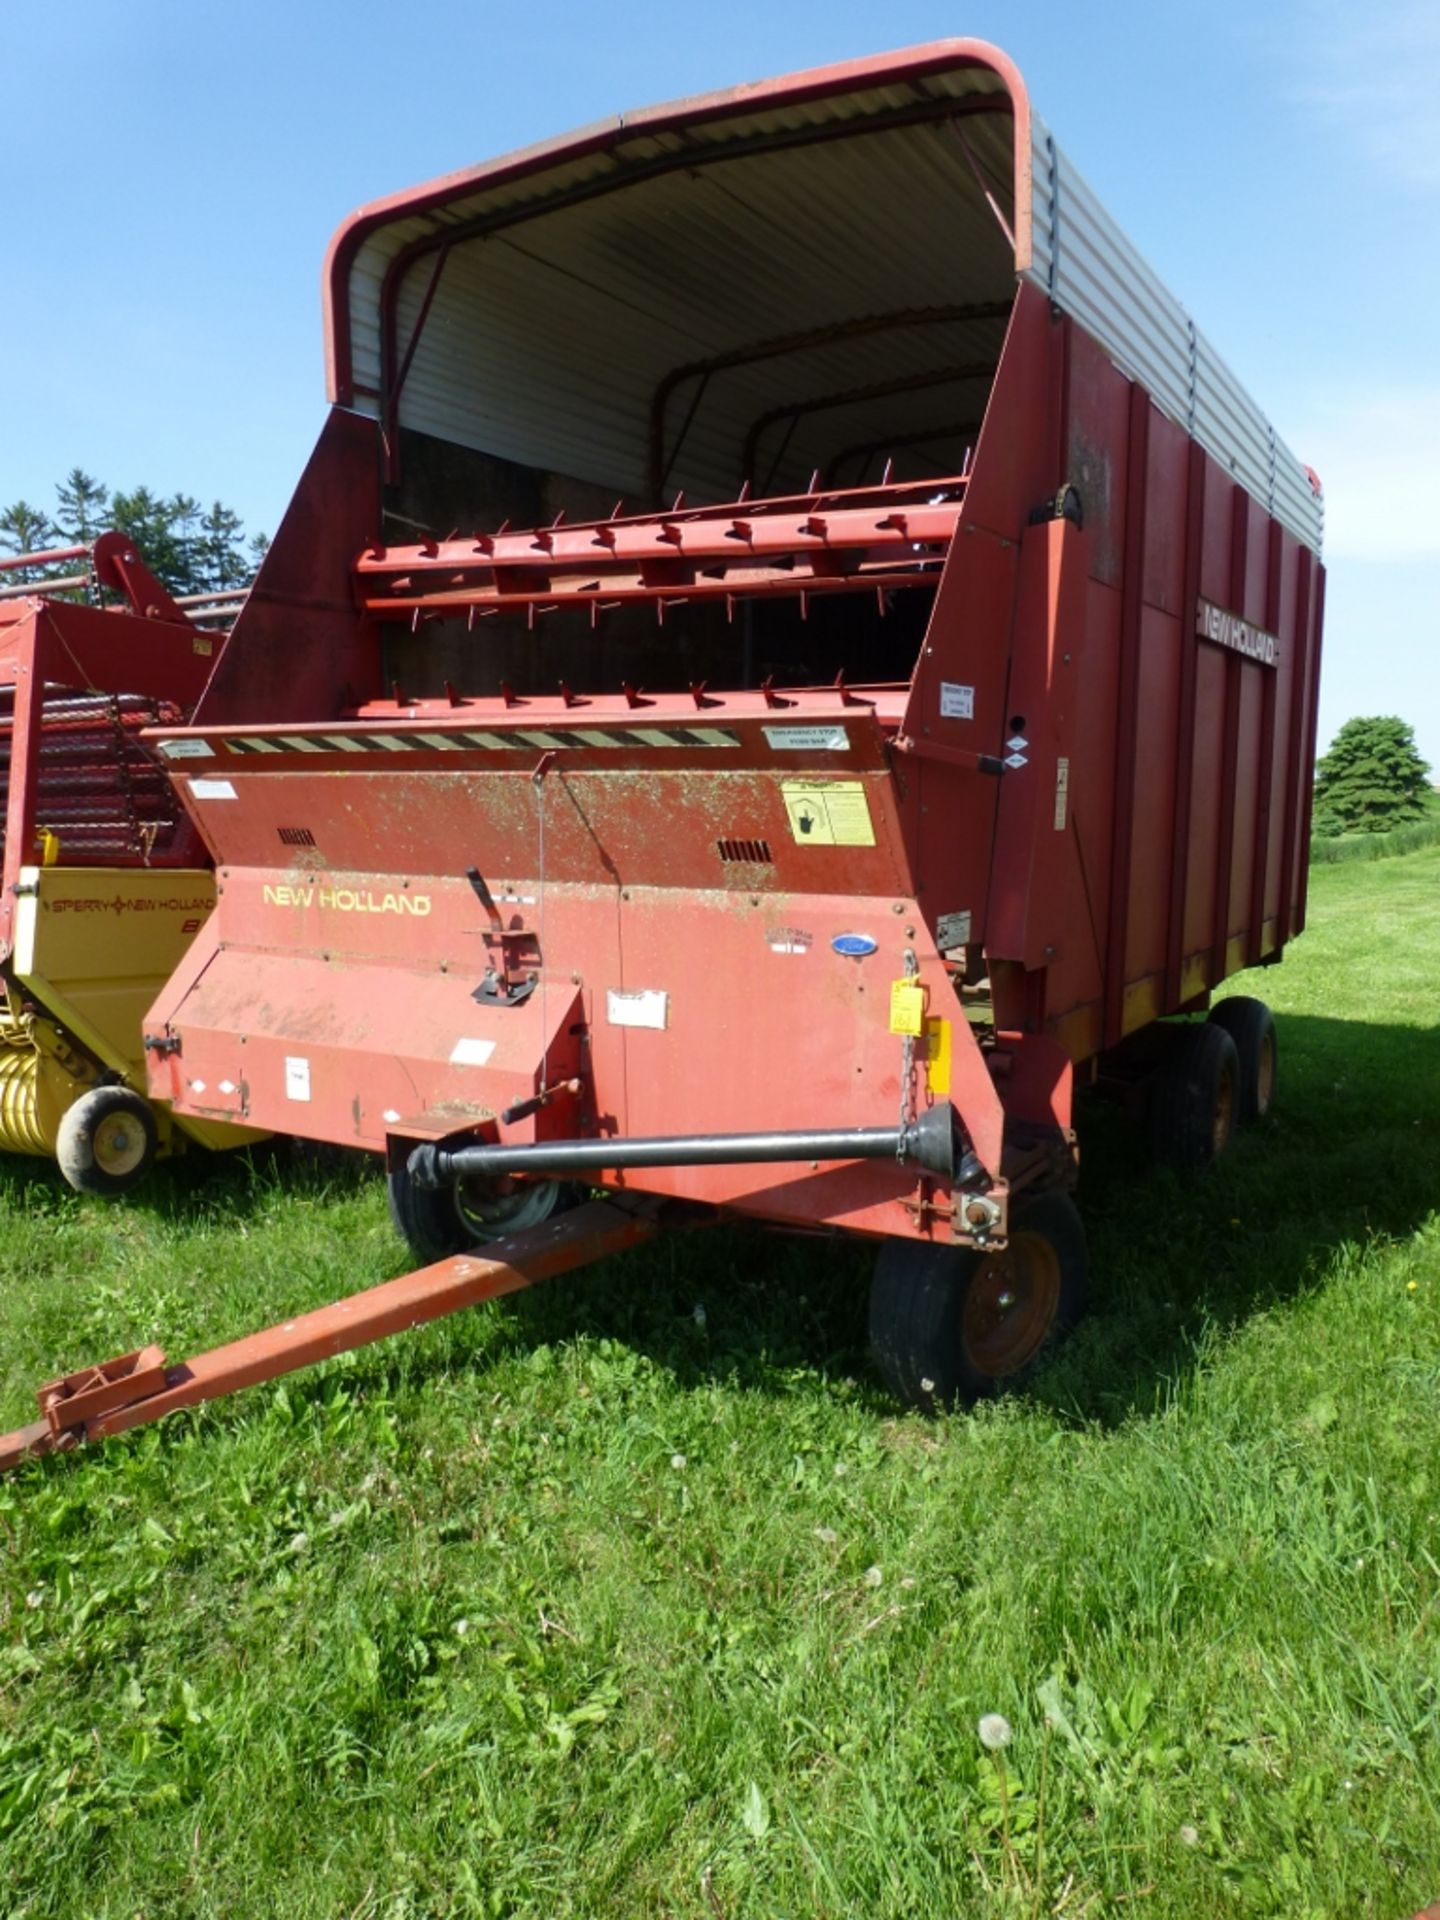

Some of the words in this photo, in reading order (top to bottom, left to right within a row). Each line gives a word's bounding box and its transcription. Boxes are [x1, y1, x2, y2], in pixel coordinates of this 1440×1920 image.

[1204, 604, 1231, 646] NEW
[1231, 617, 1275, 664] HOLLAND
[52, 899, 110, 913] SPERRY
[126, 899, 156, 911] NEW
[158, 899, 216, 911] HOLLAND
[262, 884, 314, 908] NEW
[318, 888, 432, 917] HOLLAND
